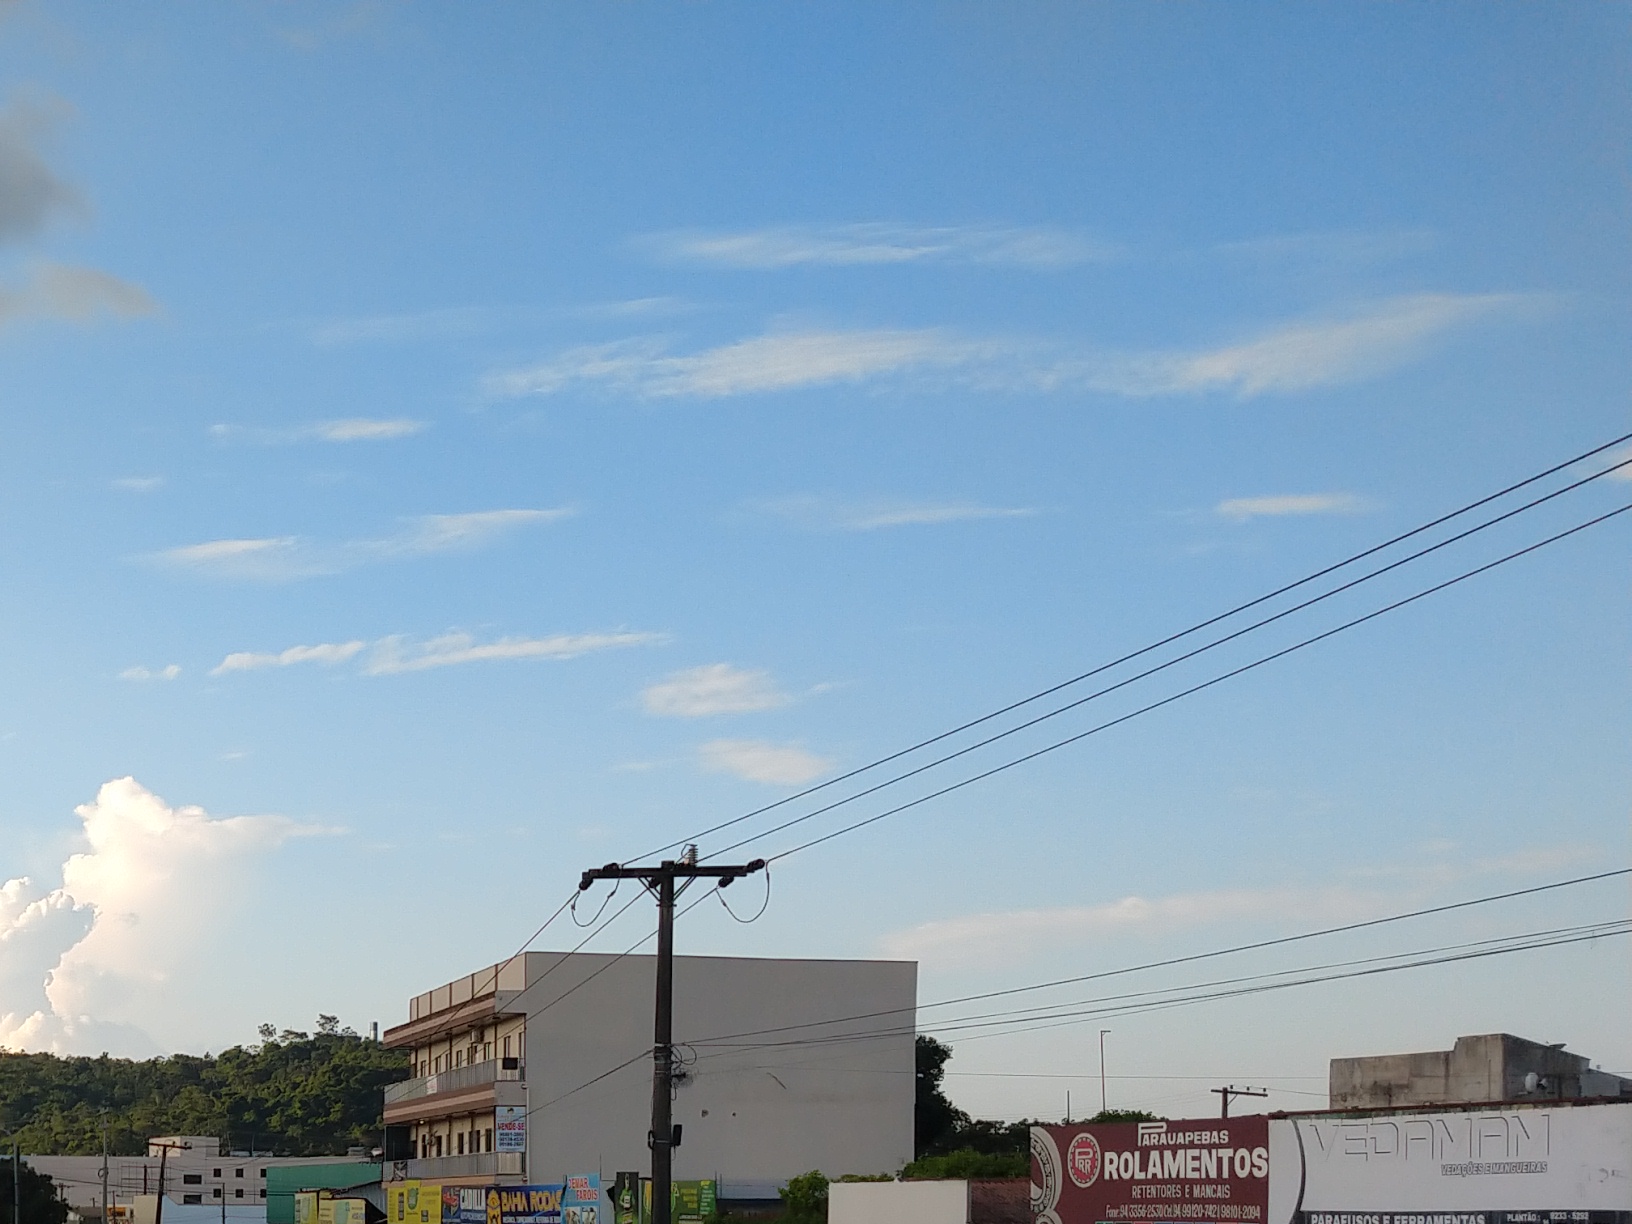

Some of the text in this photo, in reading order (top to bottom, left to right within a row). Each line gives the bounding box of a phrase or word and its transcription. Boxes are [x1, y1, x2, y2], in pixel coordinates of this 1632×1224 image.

[1137, 1122, 1229, 1147] PARAUAPEBAS
[1103, 1147, 1269, 1181] ROLAMENTOS
[1441, 1161, 1483, 1178] VEDAÇÕES
[1491, 1161, 1547, 1175] MANGUEIRAS
[501, 1191, 528, 1213] BAHIA
[1131, 1184, 1231, 1200] RETENTORES E MANCAIS
